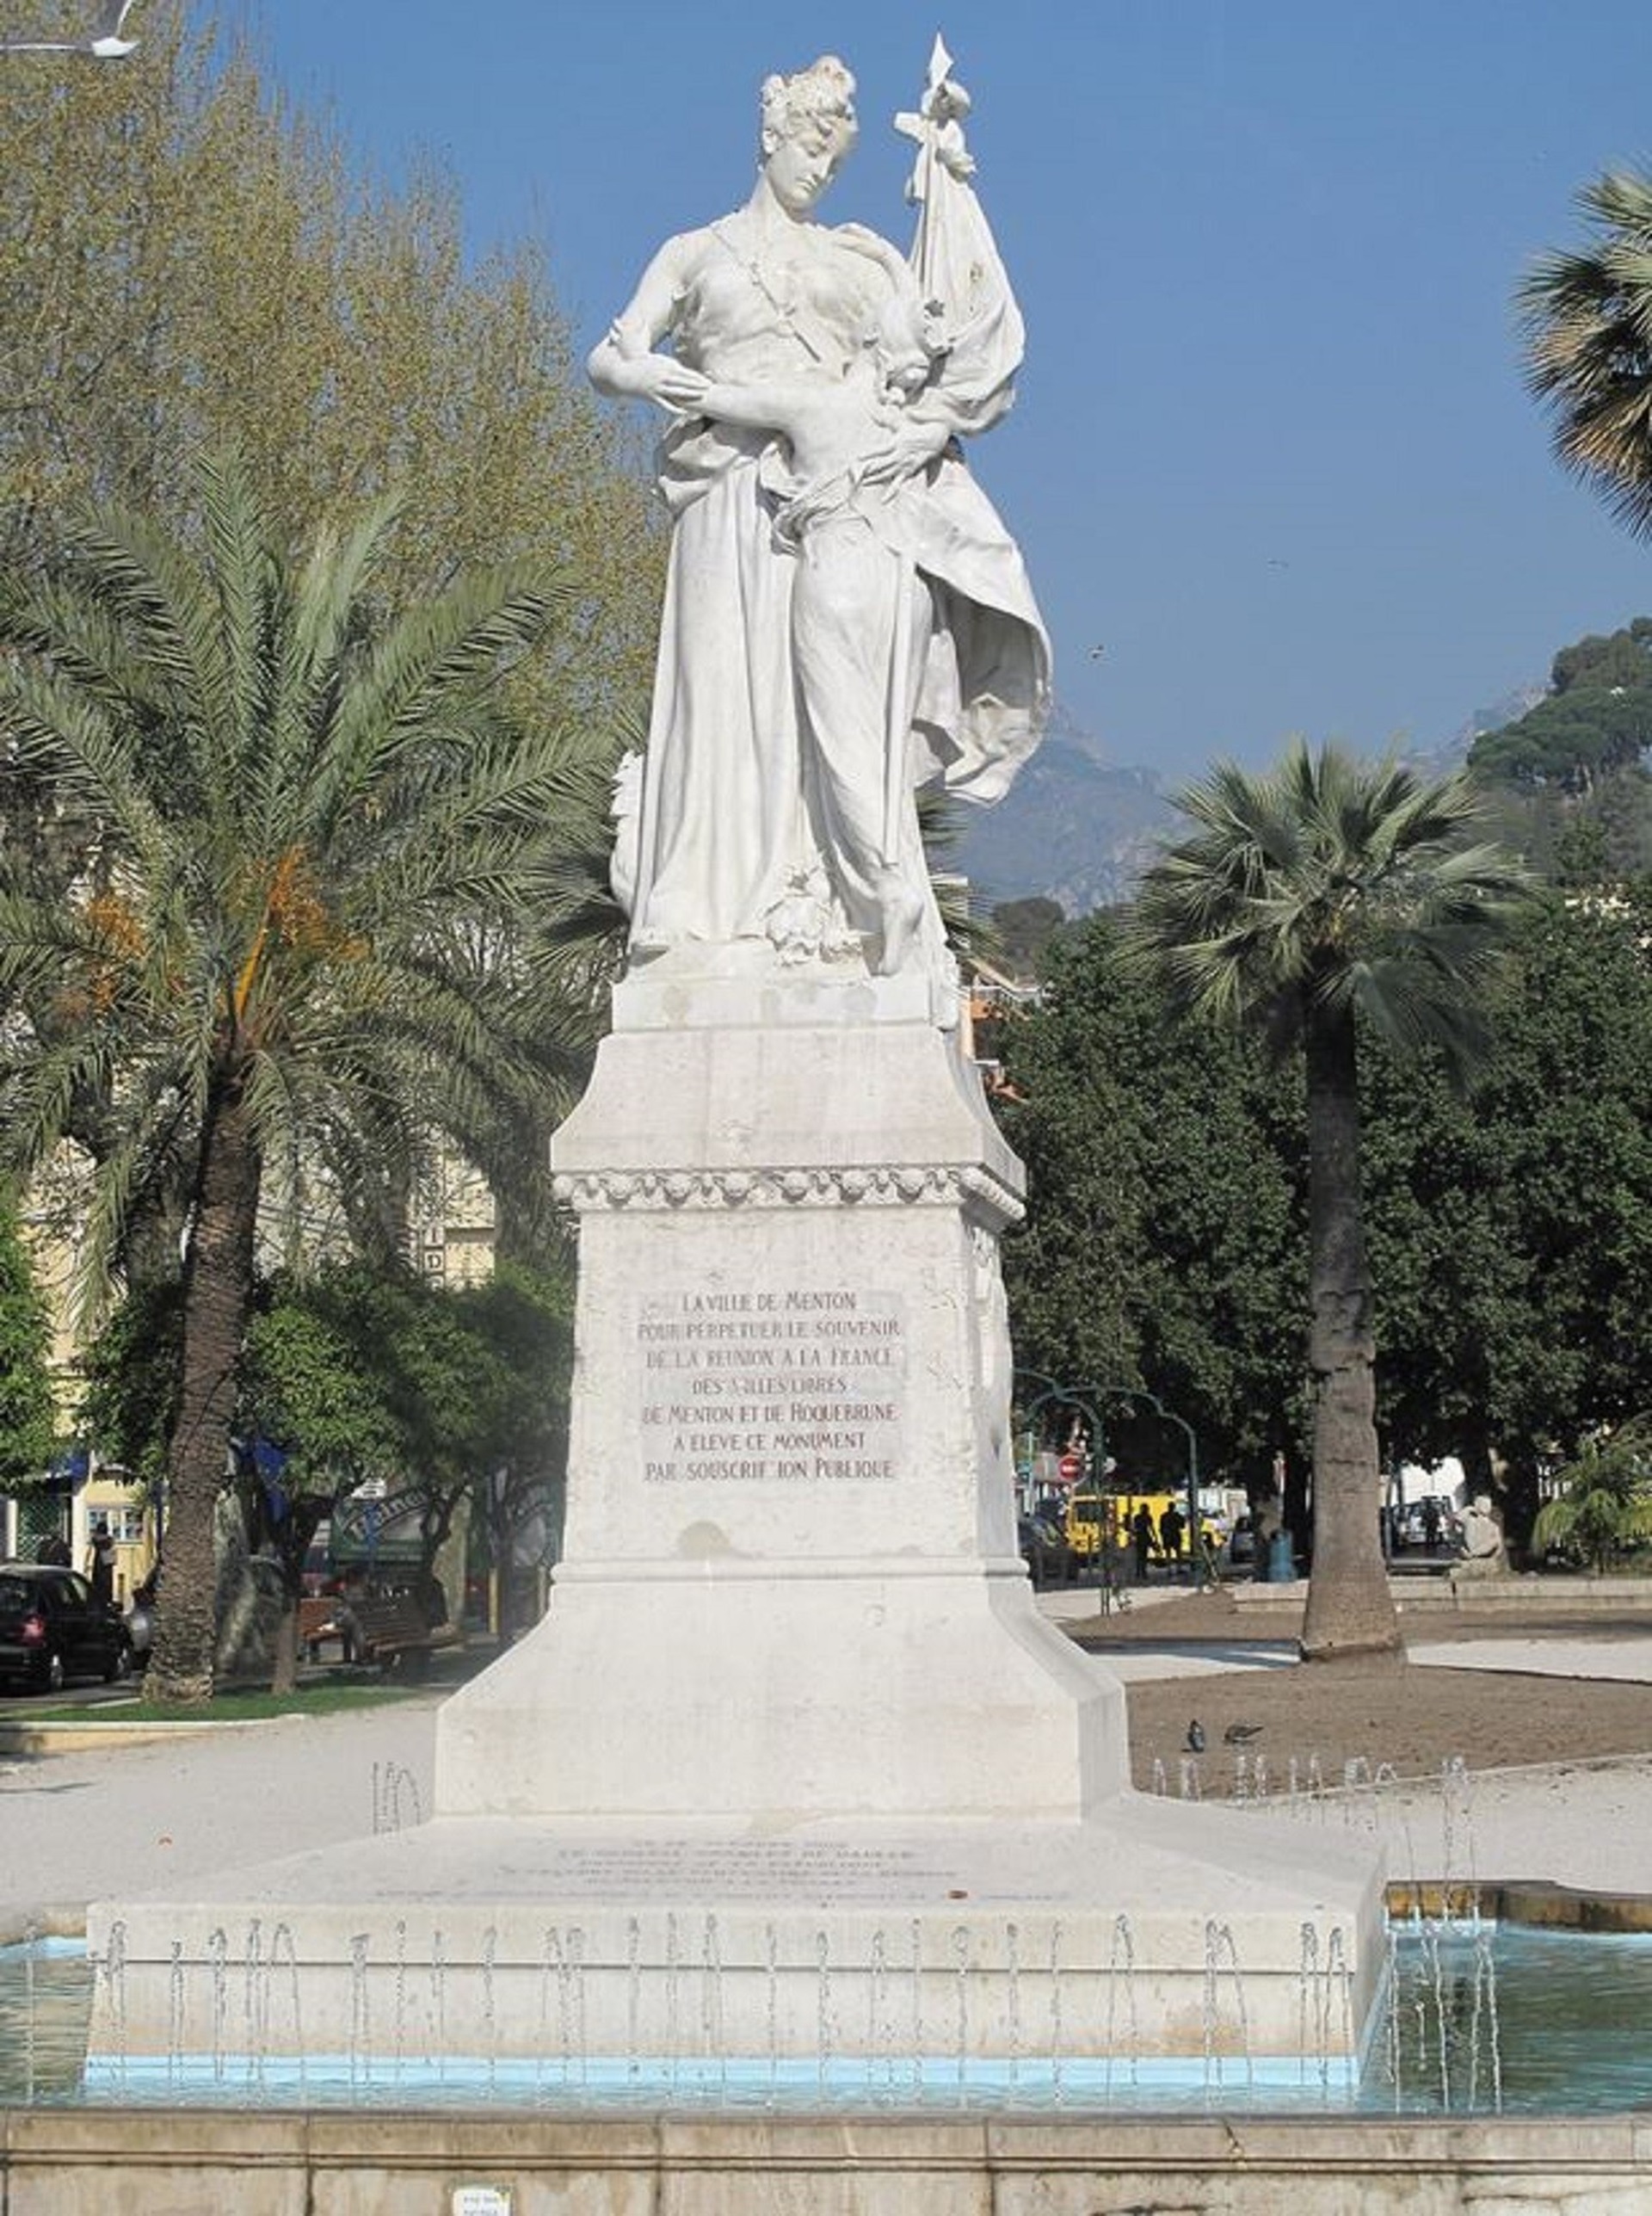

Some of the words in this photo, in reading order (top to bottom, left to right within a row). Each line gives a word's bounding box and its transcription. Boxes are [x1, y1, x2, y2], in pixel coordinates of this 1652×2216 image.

[683, 1293, 704, 1312] LA
[706, 1293, 752, 1312] VILLE
[757, 1293, 775, 1312] DE
[786, 1291, 857, 1311] MENTON
[638, 1323, 679, 1341] POUR
[788, 1320, 810, 1337] LE
[816, 1319, 900, 1336] SOUVENIR
[647, 1349, 666, 1368] DE
[675, 1350, 699, 1368] LA
[799, 1349, 820, 1367] LA
[831, 1347, 897, 1367] FRANCE
[693, 1378, 723, 1394] DES
[730, 1377, 787, 1394] VILLES
[791, 1377, 847, 1394] LIBRES
[643, 1406, 663, 1424] DE
[669, 1404, 733, 1424] MENTON
[740, 1405, 760, 1423] ET
[764, 1404, 785, 1422] DE
[791, 1402, 898, 1422] ROQUEBRUNE
[674, 1435, 685, 1451] A
[747, 1434, 767, 1451] CE
[774, 1432, 864, 1450] MONUMENT
[646, 1462, 677, 1481] PAR
[817, 1458, 896, 1478] PUBLIQUE
